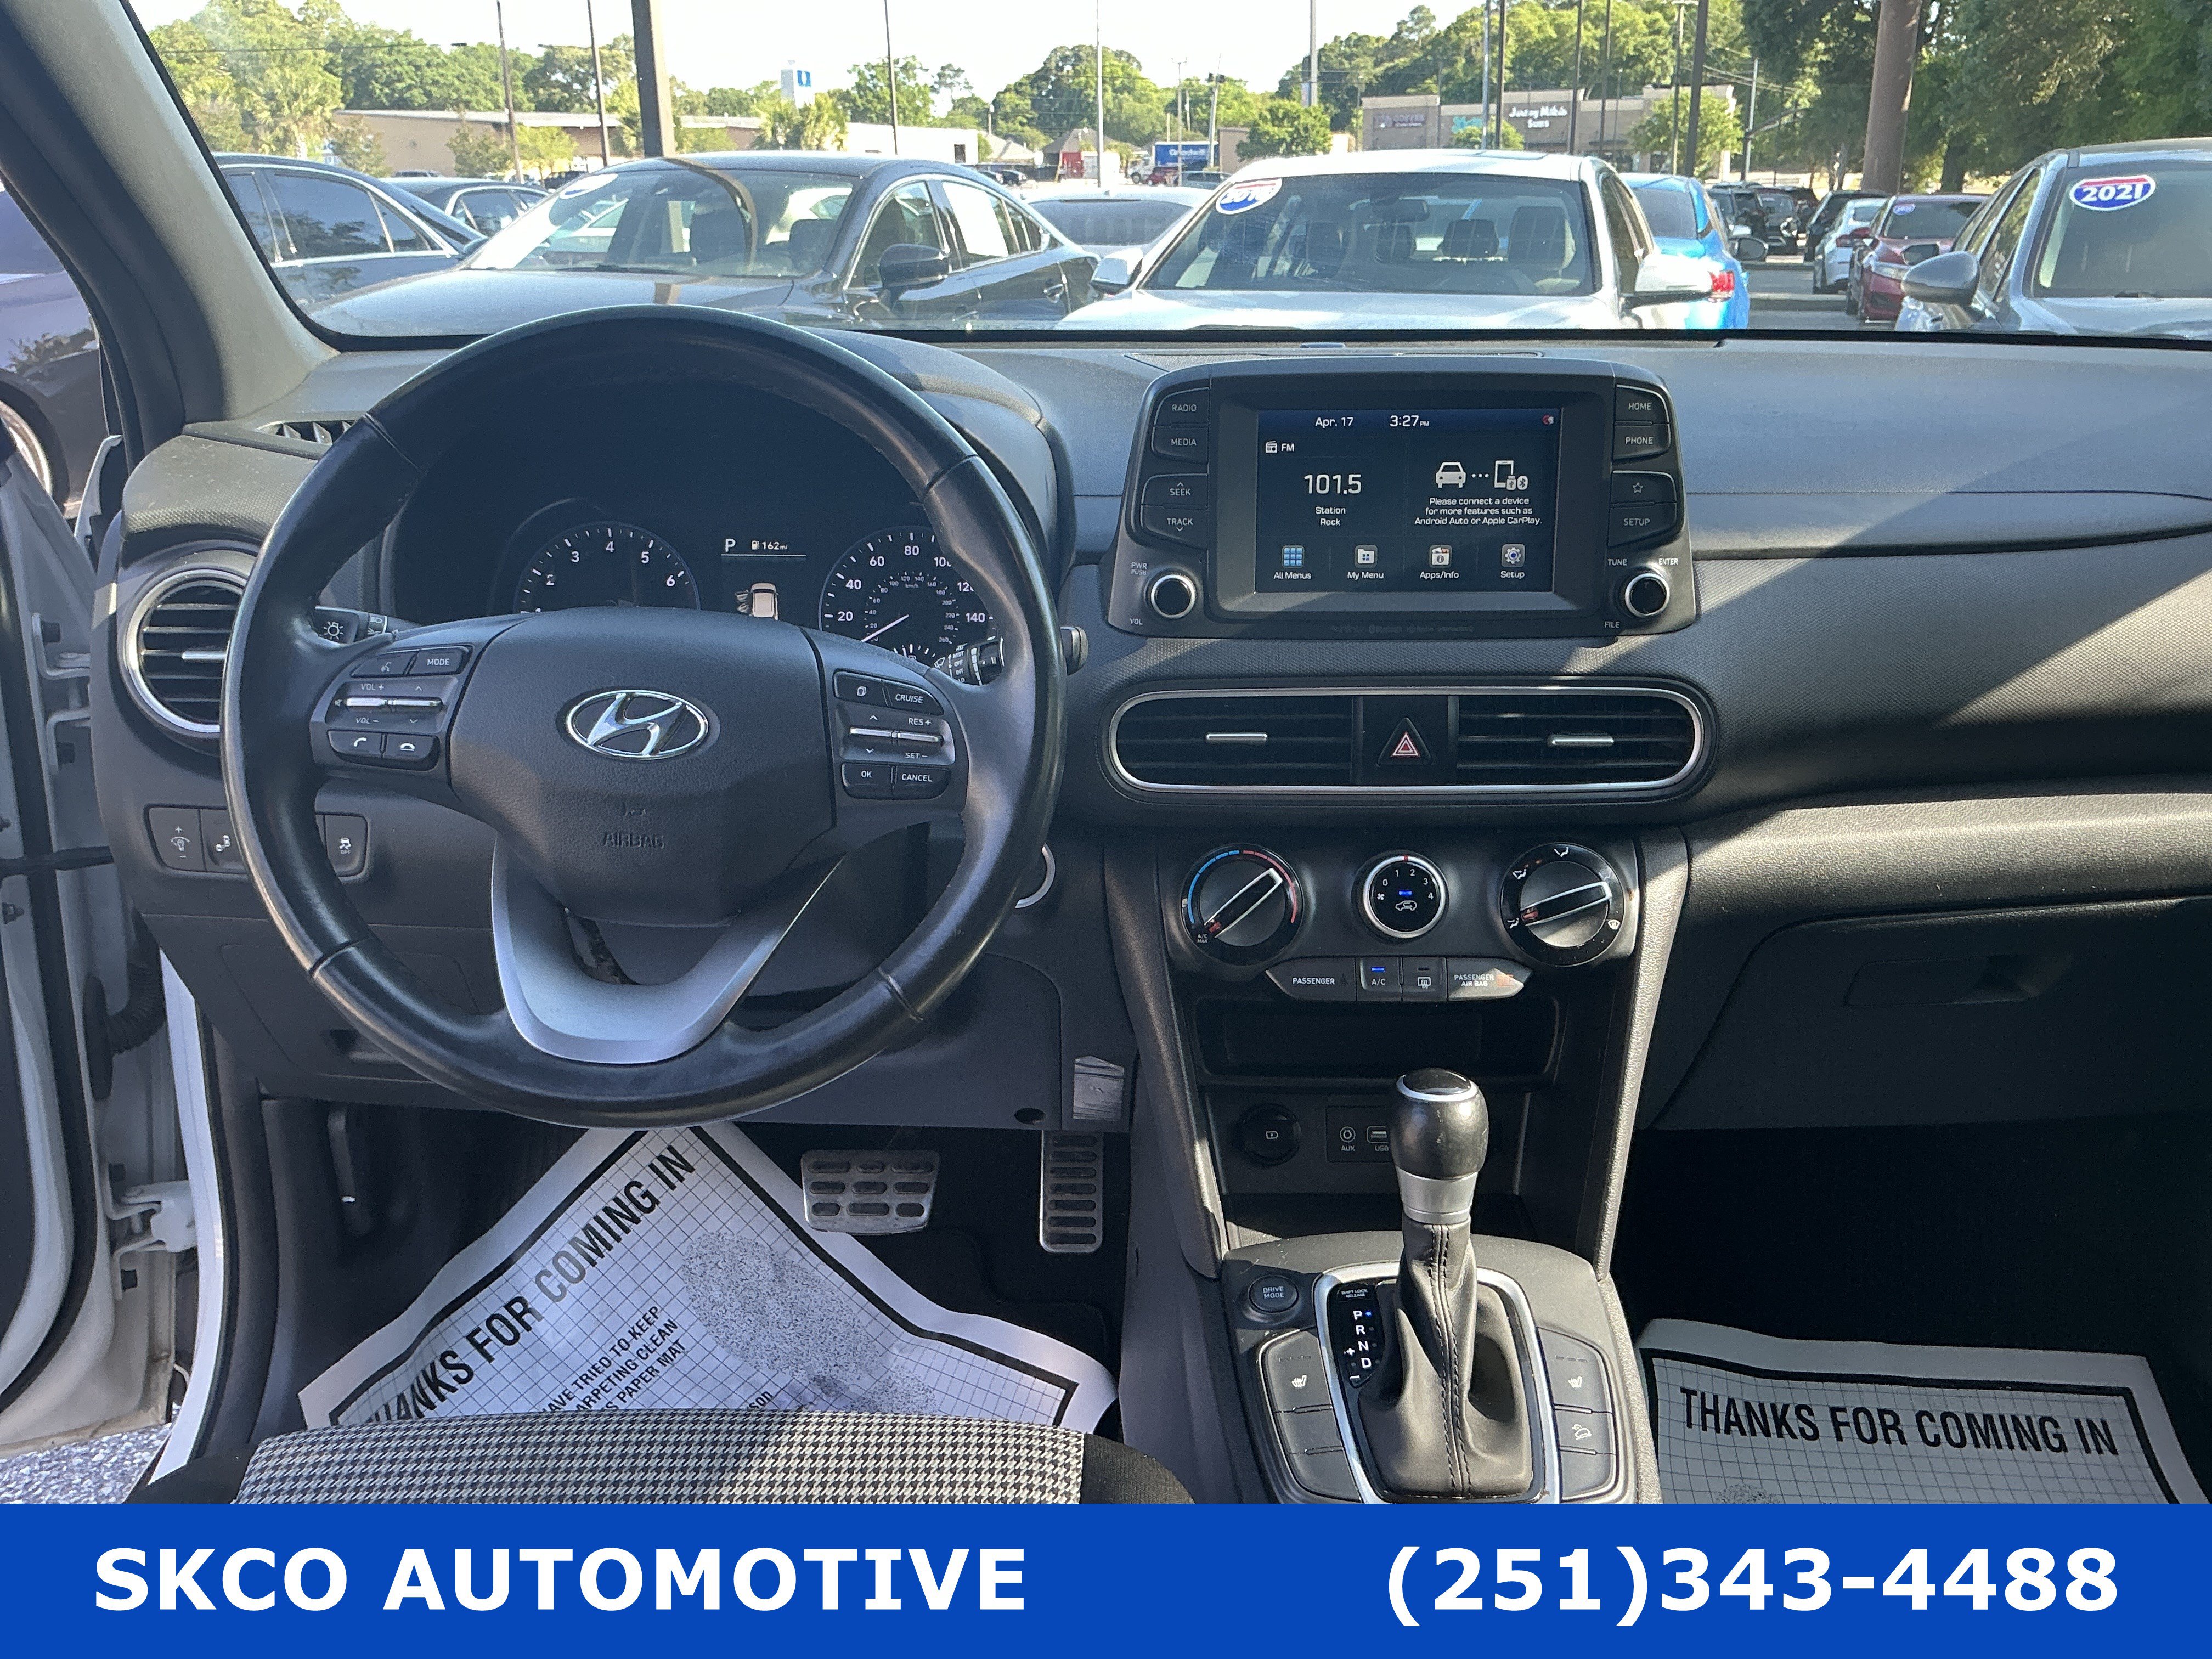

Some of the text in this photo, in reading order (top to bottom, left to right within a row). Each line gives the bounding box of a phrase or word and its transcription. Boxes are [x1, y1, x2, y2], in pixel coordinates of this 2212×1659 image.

[2080, 183, 2143, 202] 2021
[1171, 404, 1197, 412] RADIO
[1628, 402, 1652, 410] HOME
[1315, 417, 1338, 427] Apr.
[1341, 417, 1353, 426] 17
[1390, 415, 1419, 427] 3:27
[1171, 438, 1197, 446] MEDIA
[1625, 436, 1654, 445] PHONE
[1281, 443, 1295, 452] FM
[1304, 473, 1362, 495] 101.5
[1170, 488, 1191, 496] SEEK
[1429, 497, 1457, 505] Please
[1502, 497, 1530, 505] device
[1315, 506, 1346, 515] Station
[1425, 507, 1438, 515] for
[1464, 507, 1499, 515] features
[1501, 507, 1521, 515] such
[1166, 518, 1193, 526] TRACK
[1320, 518, 1341, 526] Rock
[1414, 517, 1447, 525] Android
[1449, 517, 1469, 525] Auto
[1482, 517, 1505, 527] Apple
[1507, 517, 1542, 527] CarPlay.
[1623, 518, 1651, 526] SETUP
[605, 541, 614, 553] 4
[725, 538, 736, 552] P
[904, 545, 919, 556] 80
[571, 551, 580, 562] 3
[641, 551, 650, 563] 5
[870, 556, 885, 567] 60
[545, 574, 555, 586] 2
[1273, 571, 1312, 579] All Menus
[1347, 571, 1384, 580] My Menu
[1419, 571, 1459, 580] Apps/Info
[1500, 571, 1525, 579] Setup
[666, 575, 675, 586] 6
[845, 579, 862, 590] 40
[837, 611, 854, 622] 20
[966, 612, 986, 623] 140
[426, 658, 450, 666] MODE
[360, 682, 376, 691] VOL
[895, 693, 924, 704] CRUISE
[861, 770, 872, 778] OK
[901, 773, 933, 783] CANCEL
[603, 831, 665, 850] AIRBAG
[1395, 868, 1399, 877] 1
[1410, 868, 1415, 877] 2
[1383, 878, 1389, 887] 0
[1423, 877, 1429, 885] 3
[1292, 977, 1335, 985] PASSENGER
[465, 1295, 545, 1364] FOR
[534, 1180, 661, 1304] COMING
[647, 1144, 696, 1191] IN
[1353, 1310, 1363, 1321] P
[1355, 1325, 1366, 1335] R
[636, 1318, 679, 1361] CLEAN
[571, 1356, 613, 1391] TRIED
[609, 1338, 631, 1358] TO
[627, 1305, 660, 1341] KEEP
[1358, 1340, 1369, 1352] N
[1361, 1357, 1372, 1369] D
[616, 1339, 686, 1404] PAPER MAT
[1679, 1387, 2119, 1457] THANKS FOR COMING IN
